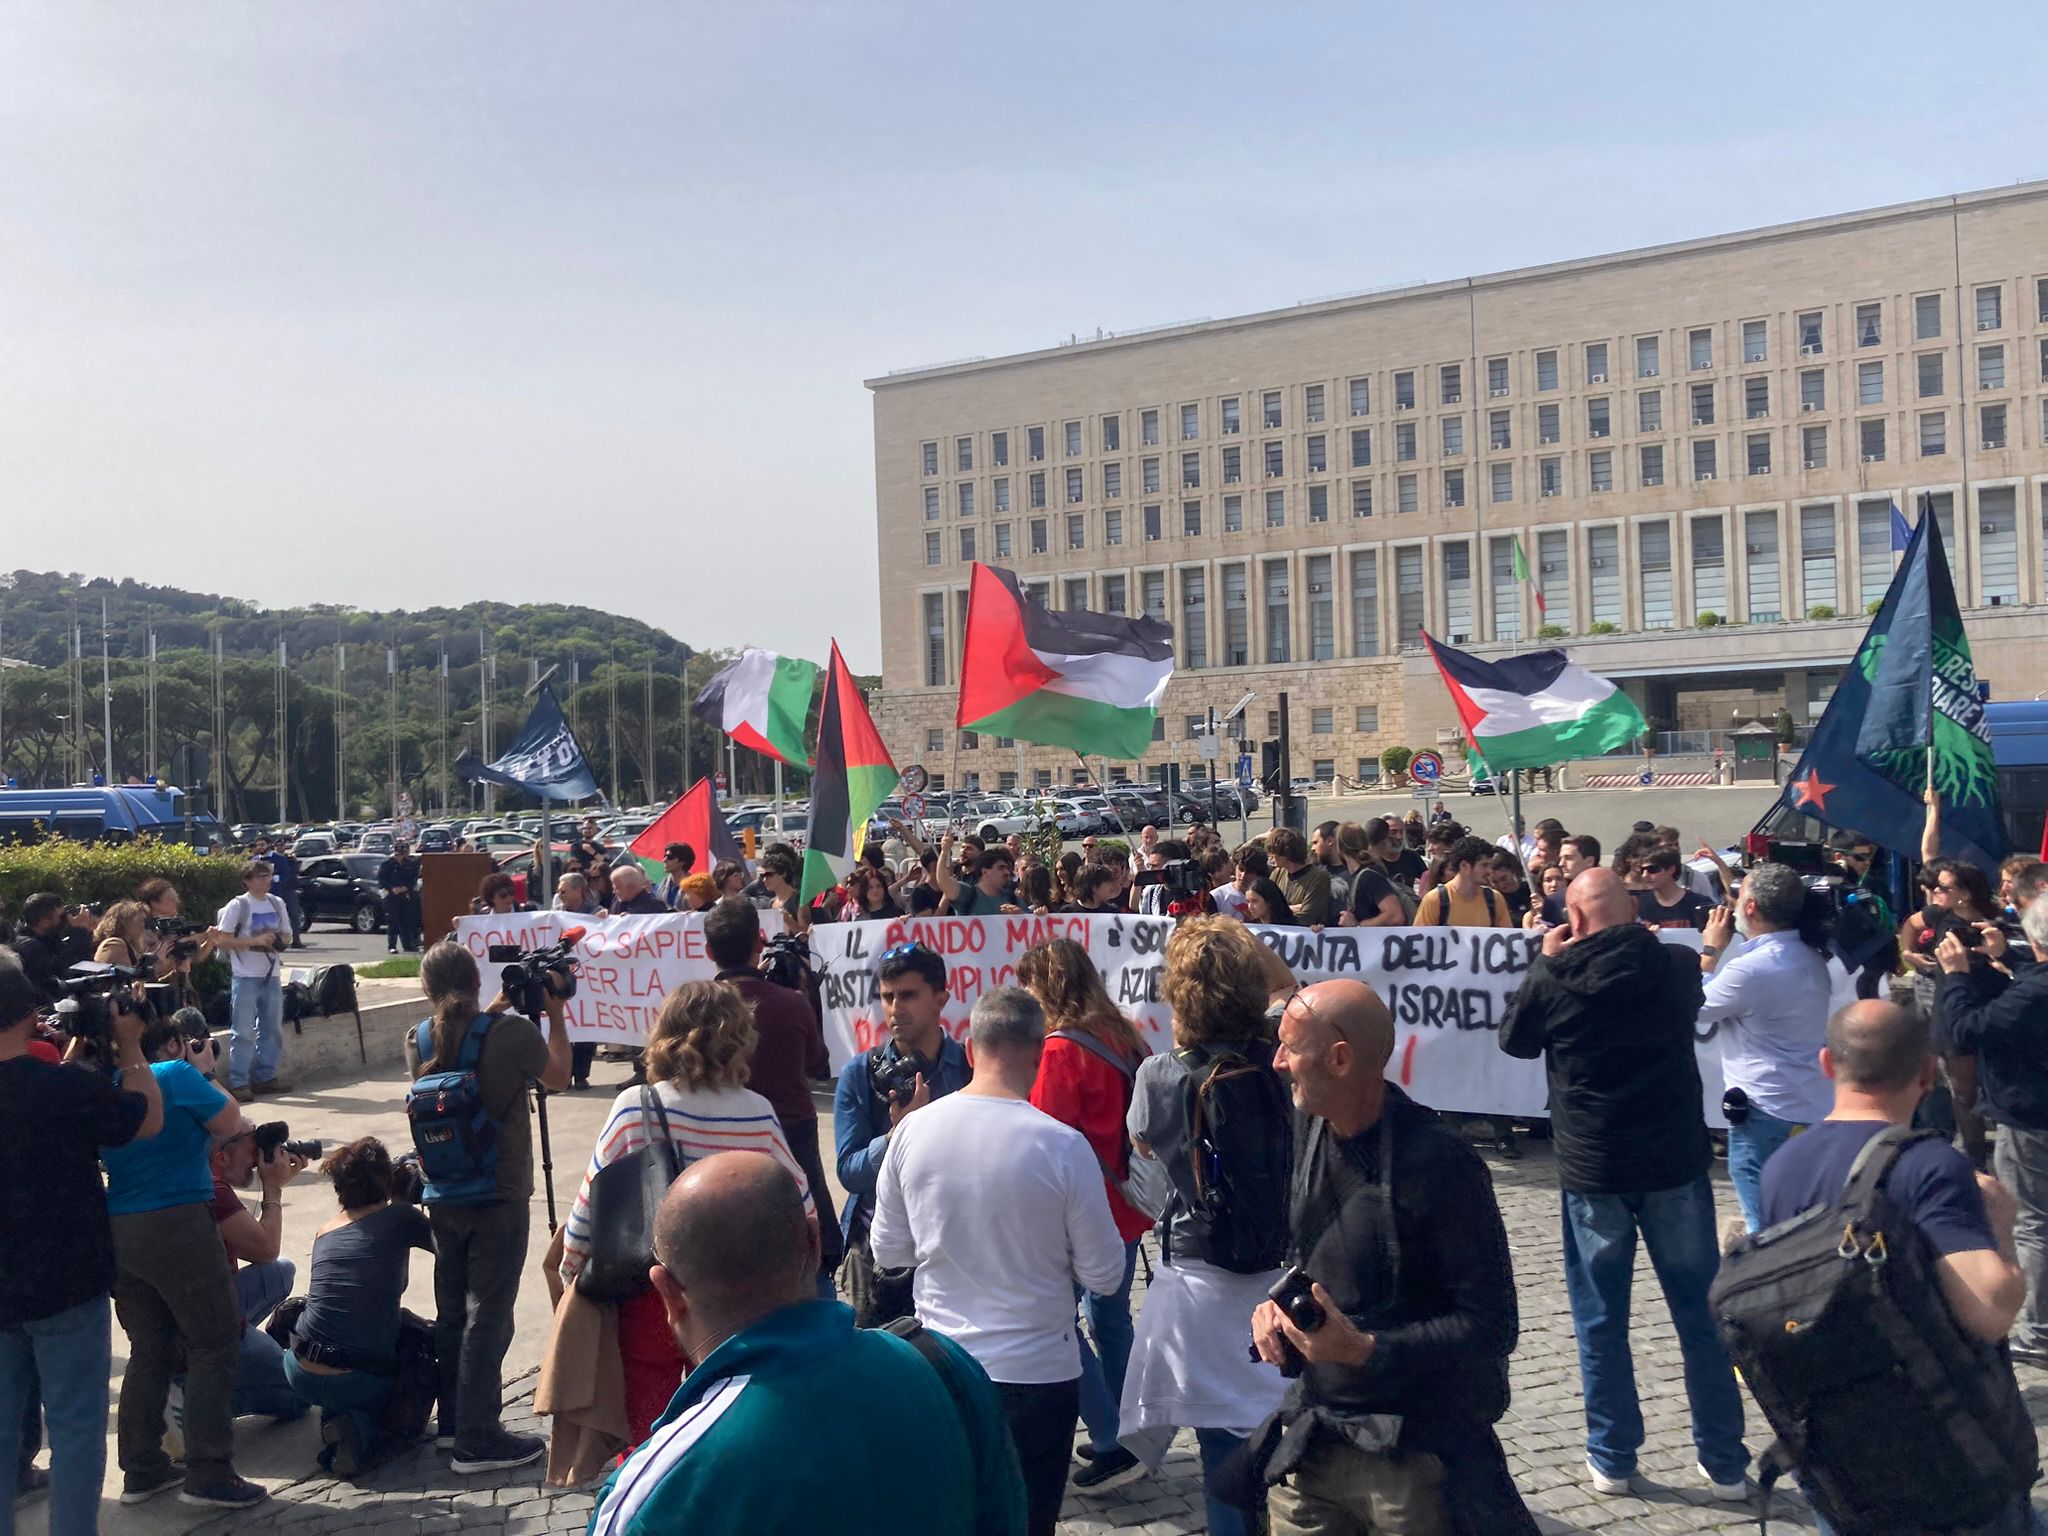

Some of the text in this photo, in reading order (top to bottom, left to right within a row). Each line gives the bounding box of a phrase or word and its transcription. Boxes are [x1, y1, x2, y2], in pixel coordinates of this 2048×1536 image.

[468, 926, 607, 959] COMITO
[846, 928, 868, 960] IL
[630, 968, 665, 996] LA
[1119, 966, 1163, 1004] AZIE
[1388, 983, 1521, 1032] ISRAEL
